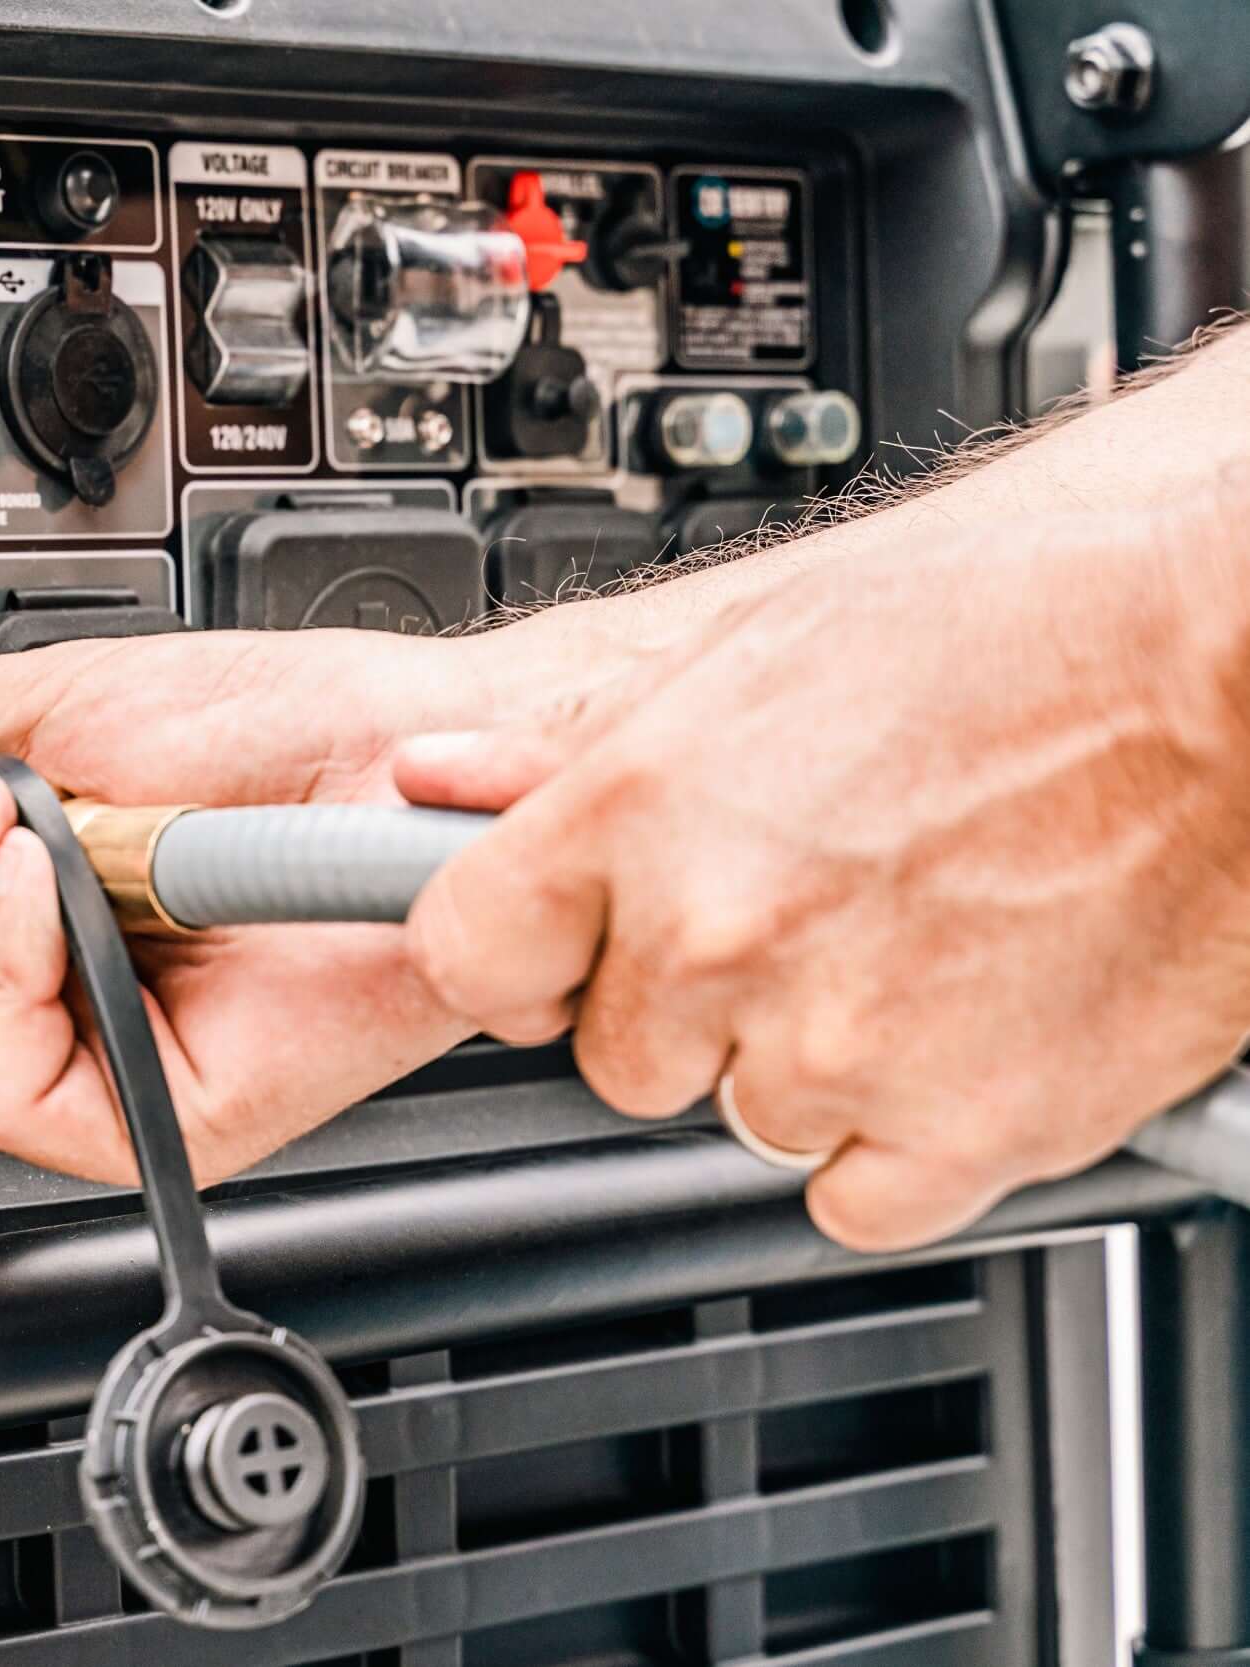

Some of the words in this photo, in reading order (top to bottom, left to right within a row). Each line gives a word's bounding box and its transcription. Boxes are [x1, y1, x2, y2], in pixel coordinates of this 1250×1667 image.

[201, 152, 269, 176] VOLTAGE
[326, 160, 380, 178] CIRCUIT
[196, 196, 237, 222] 120V
[240, 197, 283, 223] ONLY
